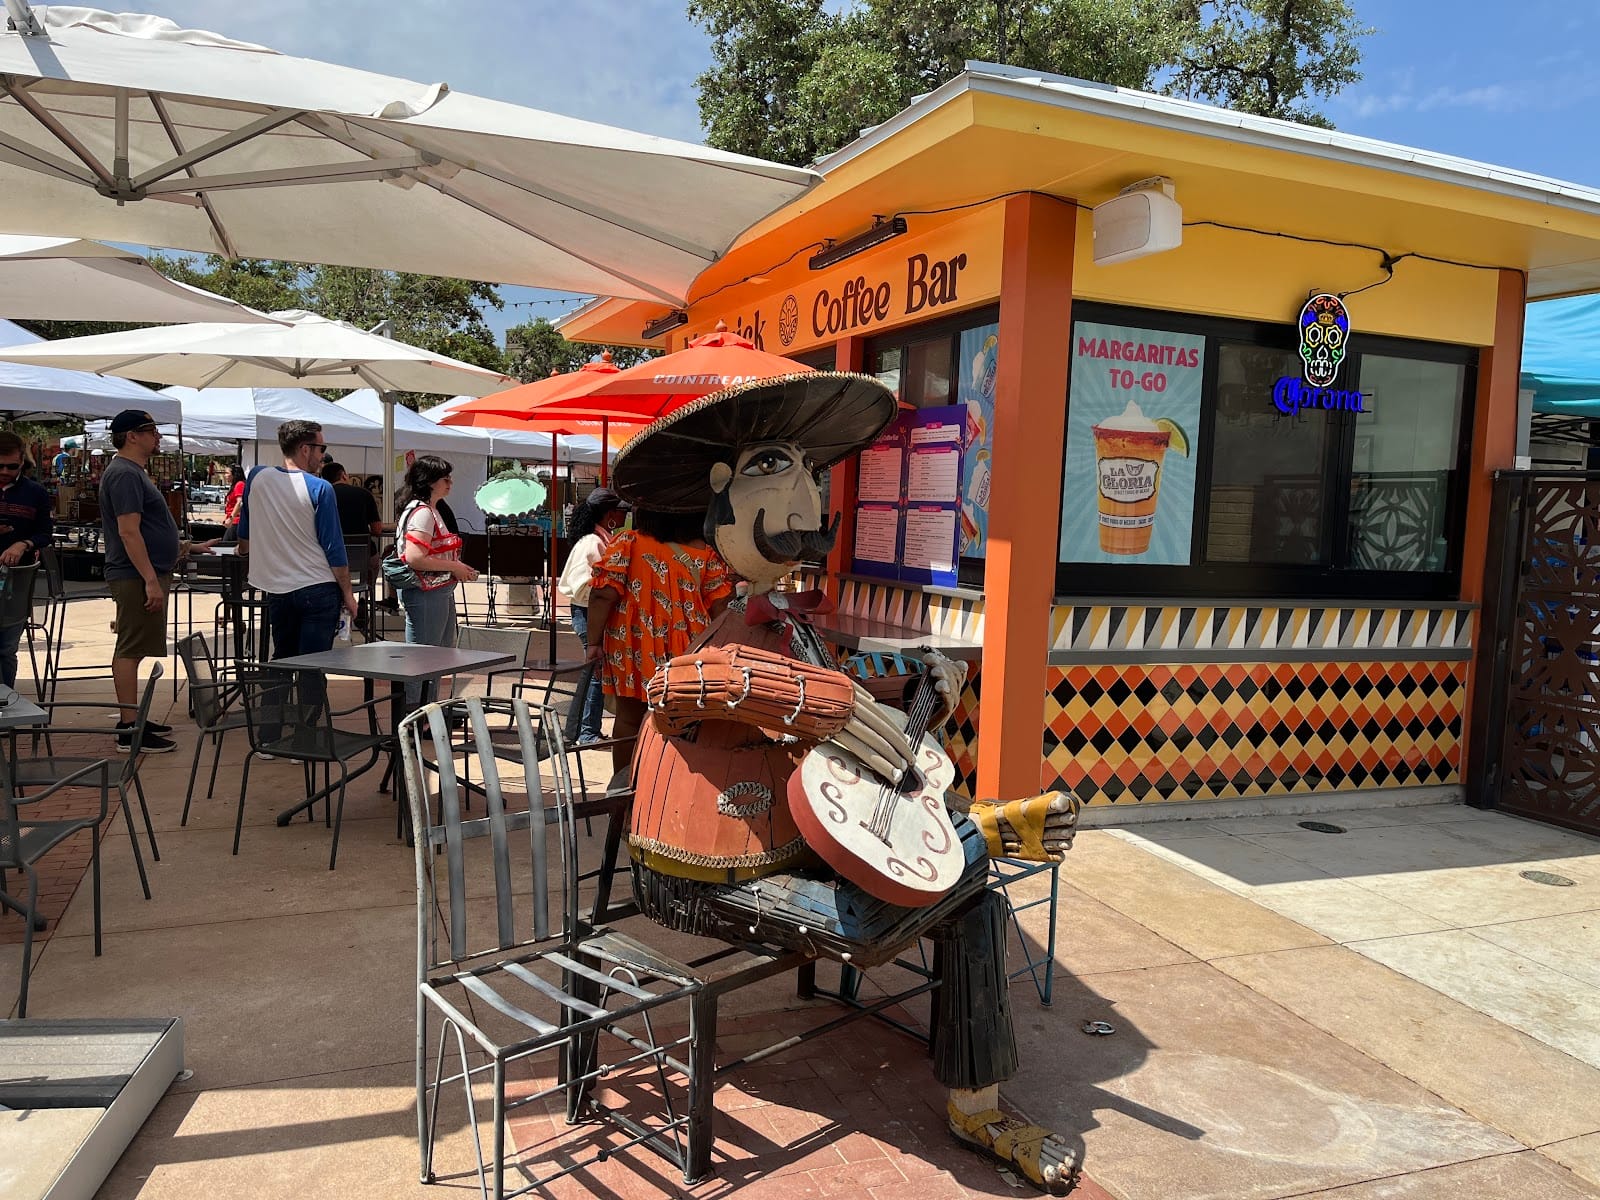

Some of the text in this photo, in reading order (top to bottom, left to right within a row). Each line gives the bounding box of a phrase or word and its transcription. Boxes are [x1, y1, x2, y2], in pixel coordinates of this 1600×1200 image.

[812, 275, 891, 338] Coffee
[905, 252, 967, 315] Bar
[1078, 336, 1199, 368] MARGARITAS
[1109, 368, 1167, 393] TO-GO
[1272, 375, 1364, 416] Corona
[1103, 475, 1152, 489] GLORIA
[1110, 468, 1126, 476] LA
